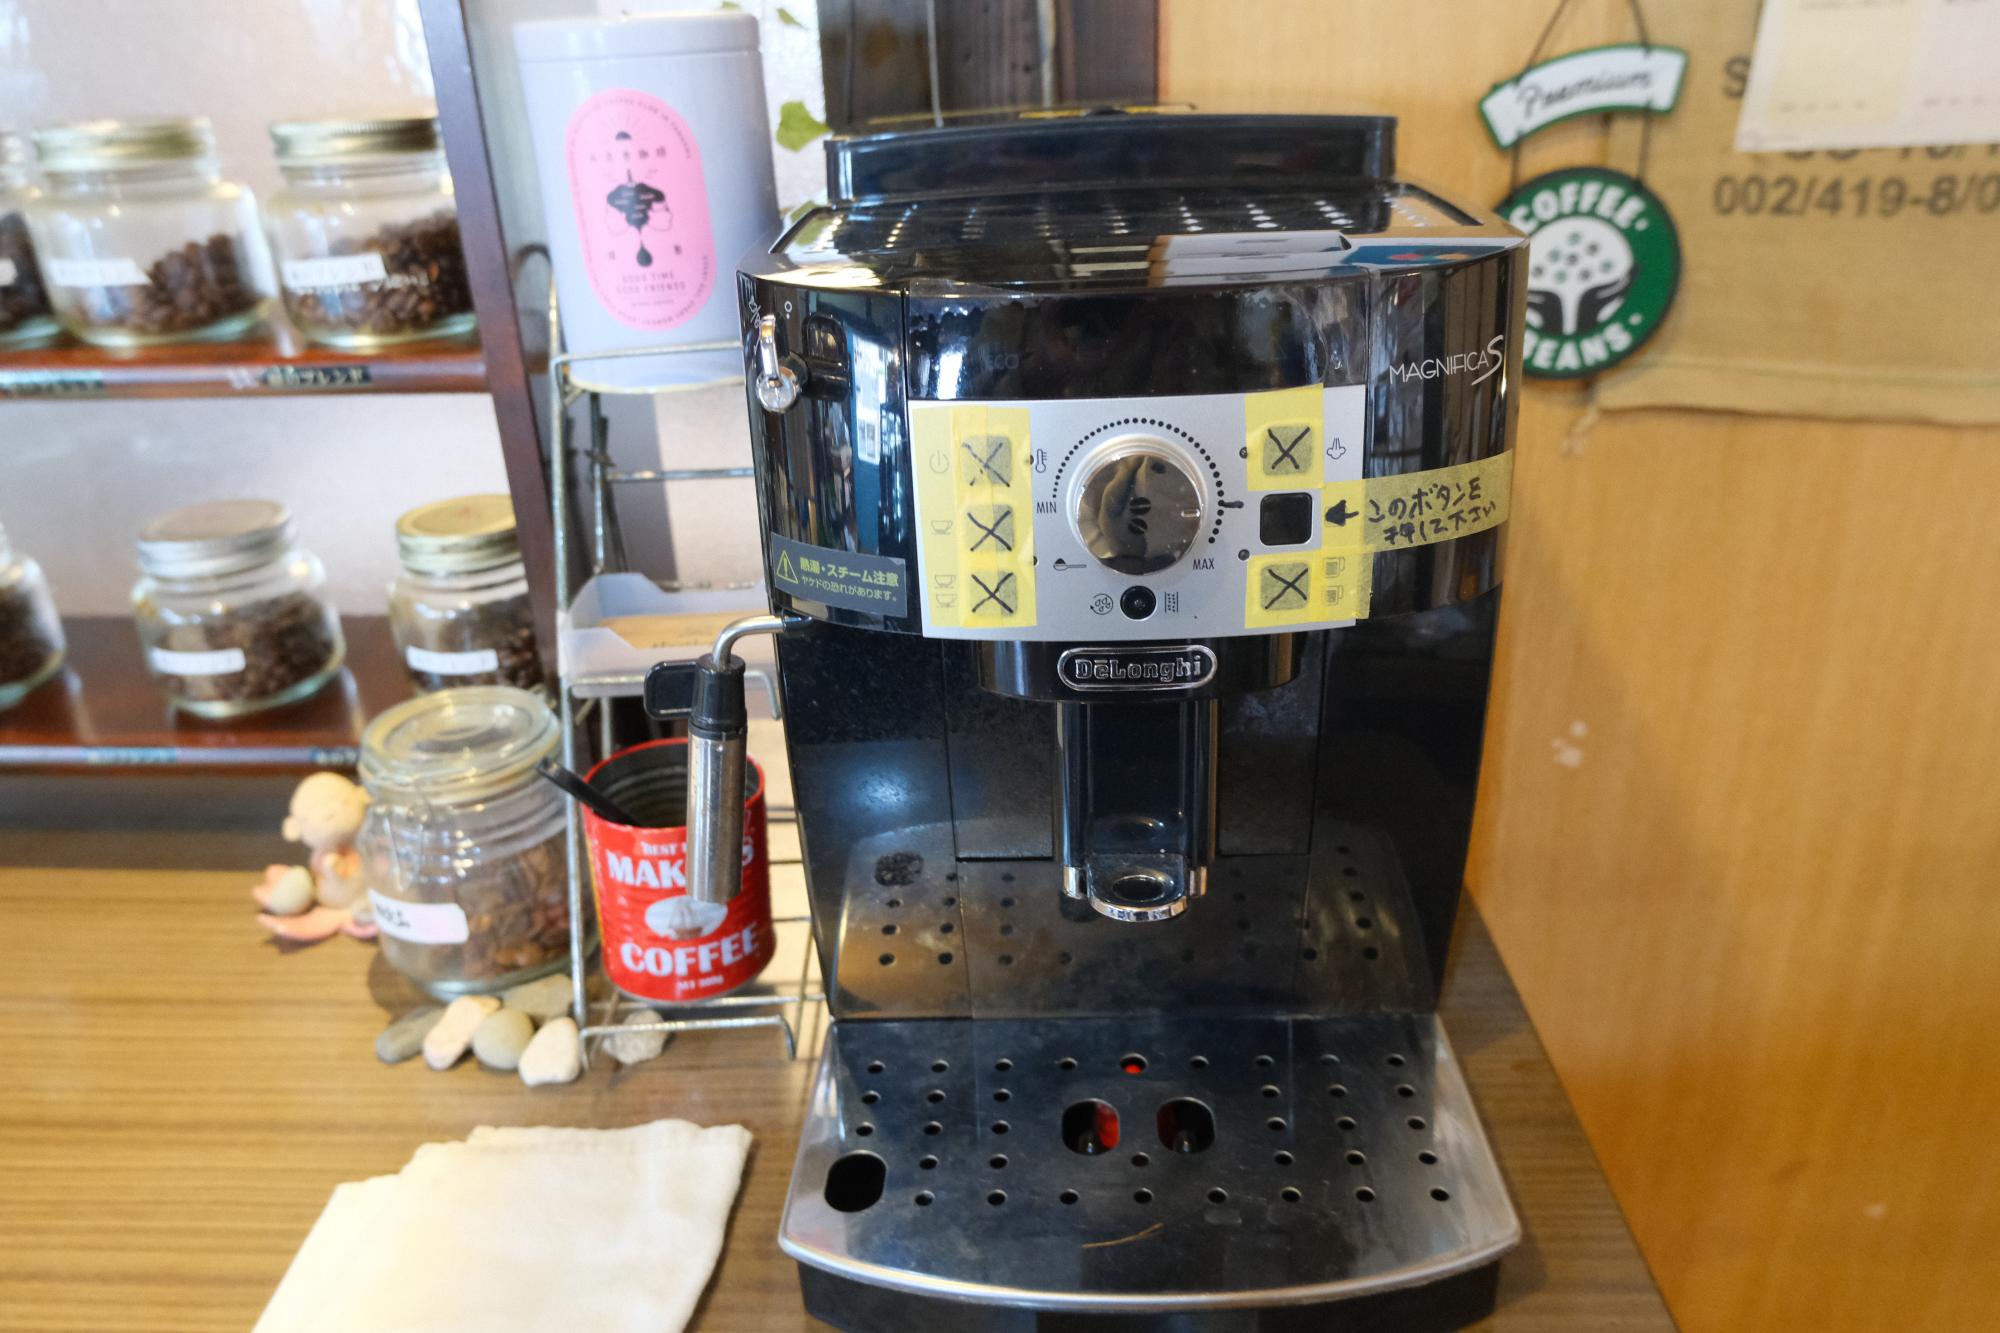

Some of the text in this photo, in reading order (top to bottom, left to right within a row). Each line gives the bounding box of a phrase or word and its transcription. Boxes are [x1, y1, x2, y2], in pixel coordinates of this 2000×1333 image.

[1516, 73, 1650, 118] Premium
[1509, 181, 1645, 234] COFFEE
[1036, 502, 1058, 515] MIN
[1192, 557, 1216, 571] MAX
[620, 923, 758, 978] COFFEE
